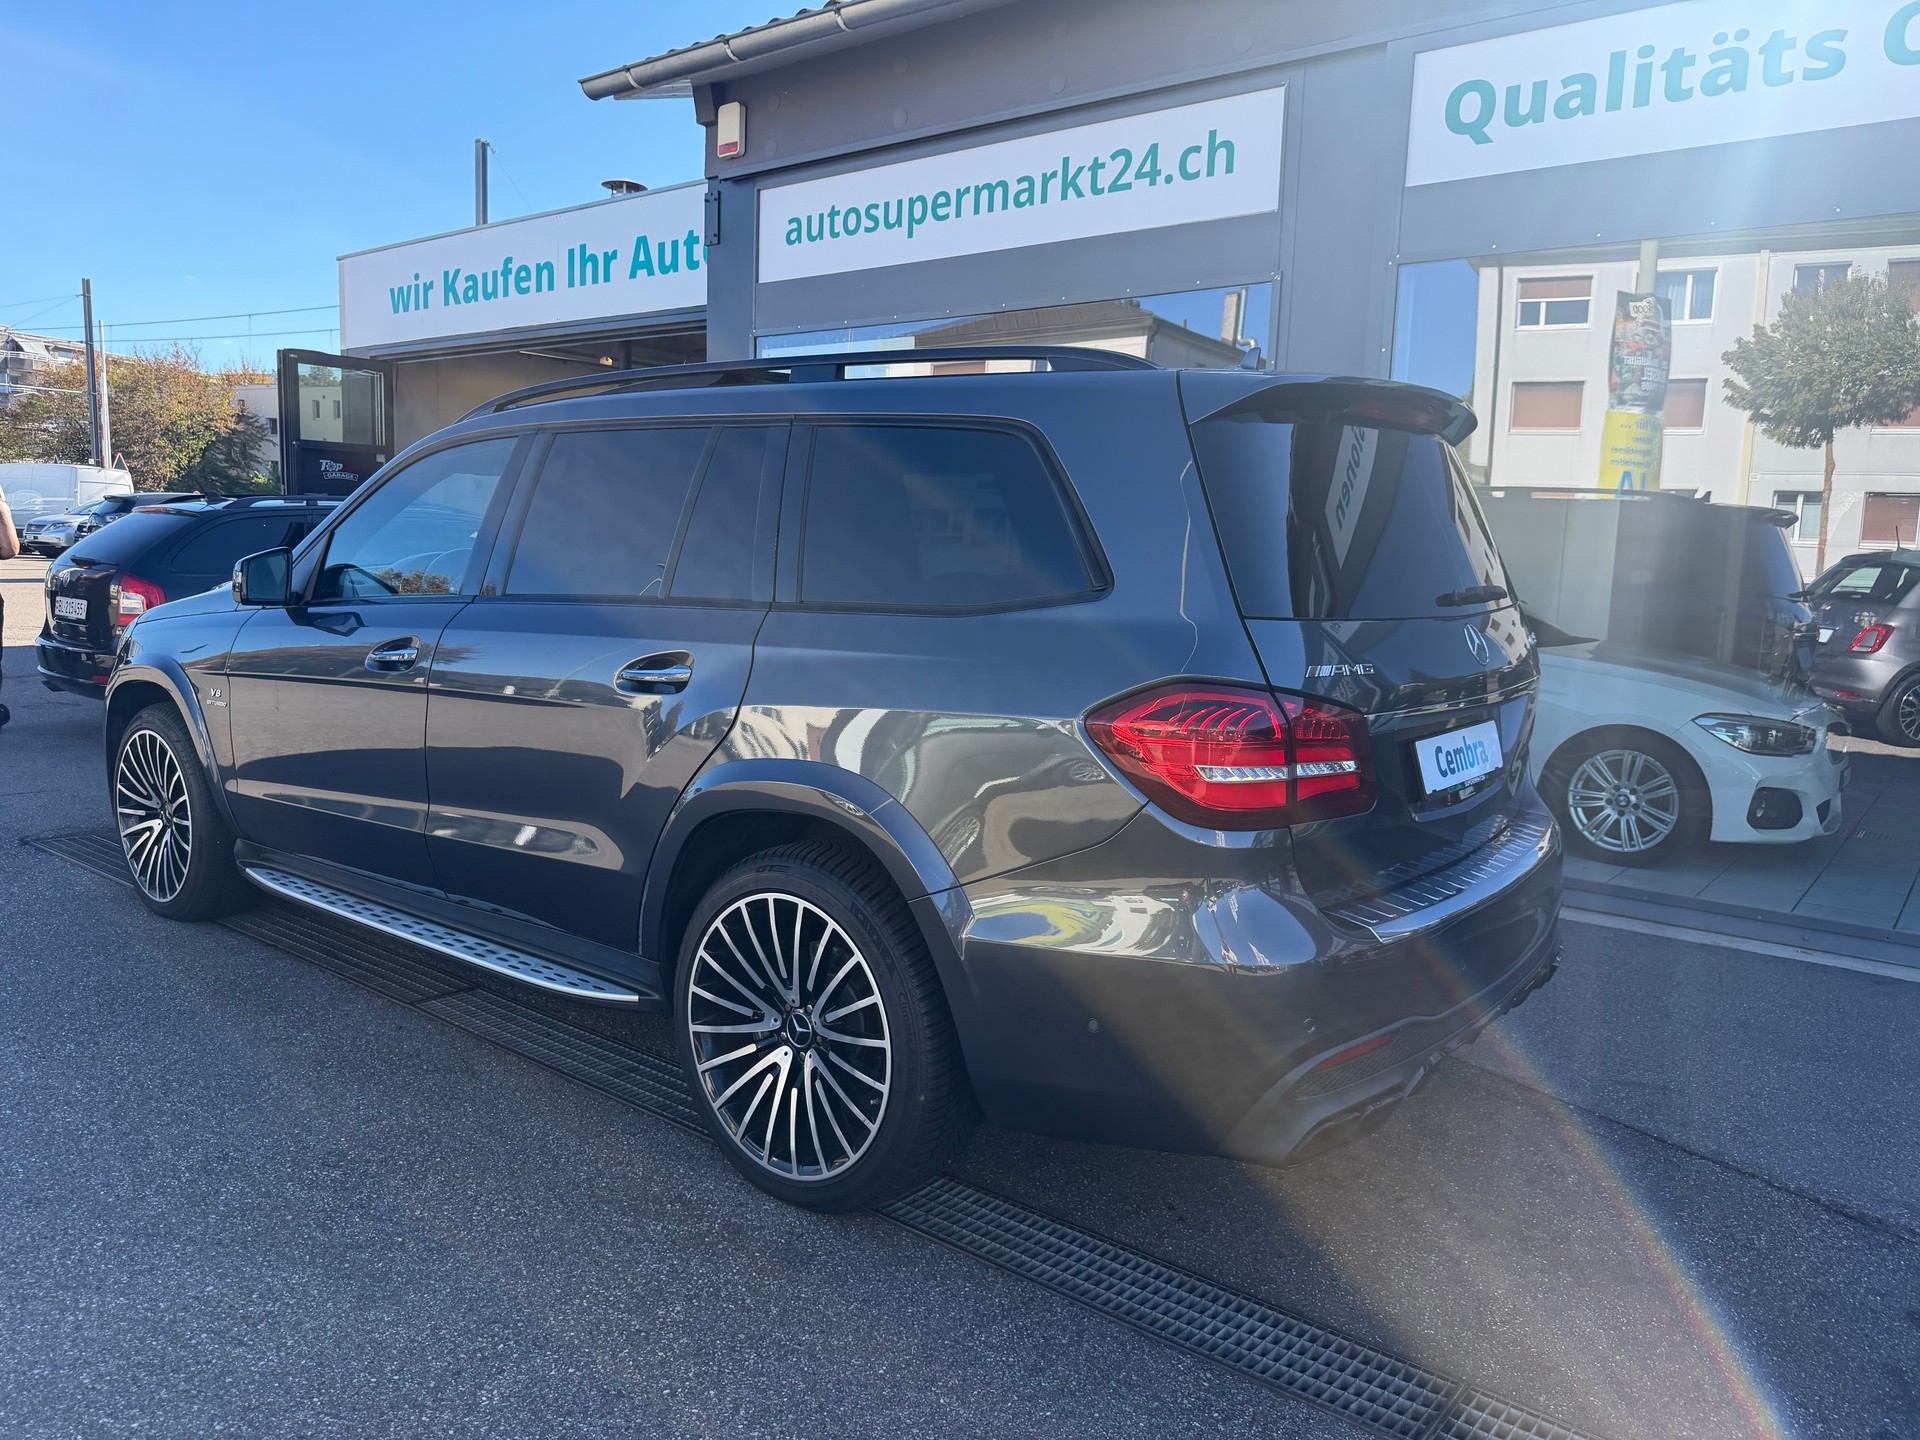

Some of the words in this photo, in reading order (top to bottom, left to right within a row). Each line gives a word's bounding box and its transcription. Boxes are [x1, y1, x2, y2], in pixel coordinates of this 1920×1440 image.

[1444, 27, 1849, 146] Qualitäts
[784, 128, 1236, 247] autosupermarkt24.ch
[389, 272, 435, 315] wir
[443, 256, 556, 307] Kaufen
[567, 242, 618, 289] Ihr
[628, 229, 708, 281] Aut
[320, 459, 344, 472] Top
[1330, 663, 1376, 677] AMG
[210, 688, 222, 698] V8
[1434, 735, 1489, 778] Cembra
